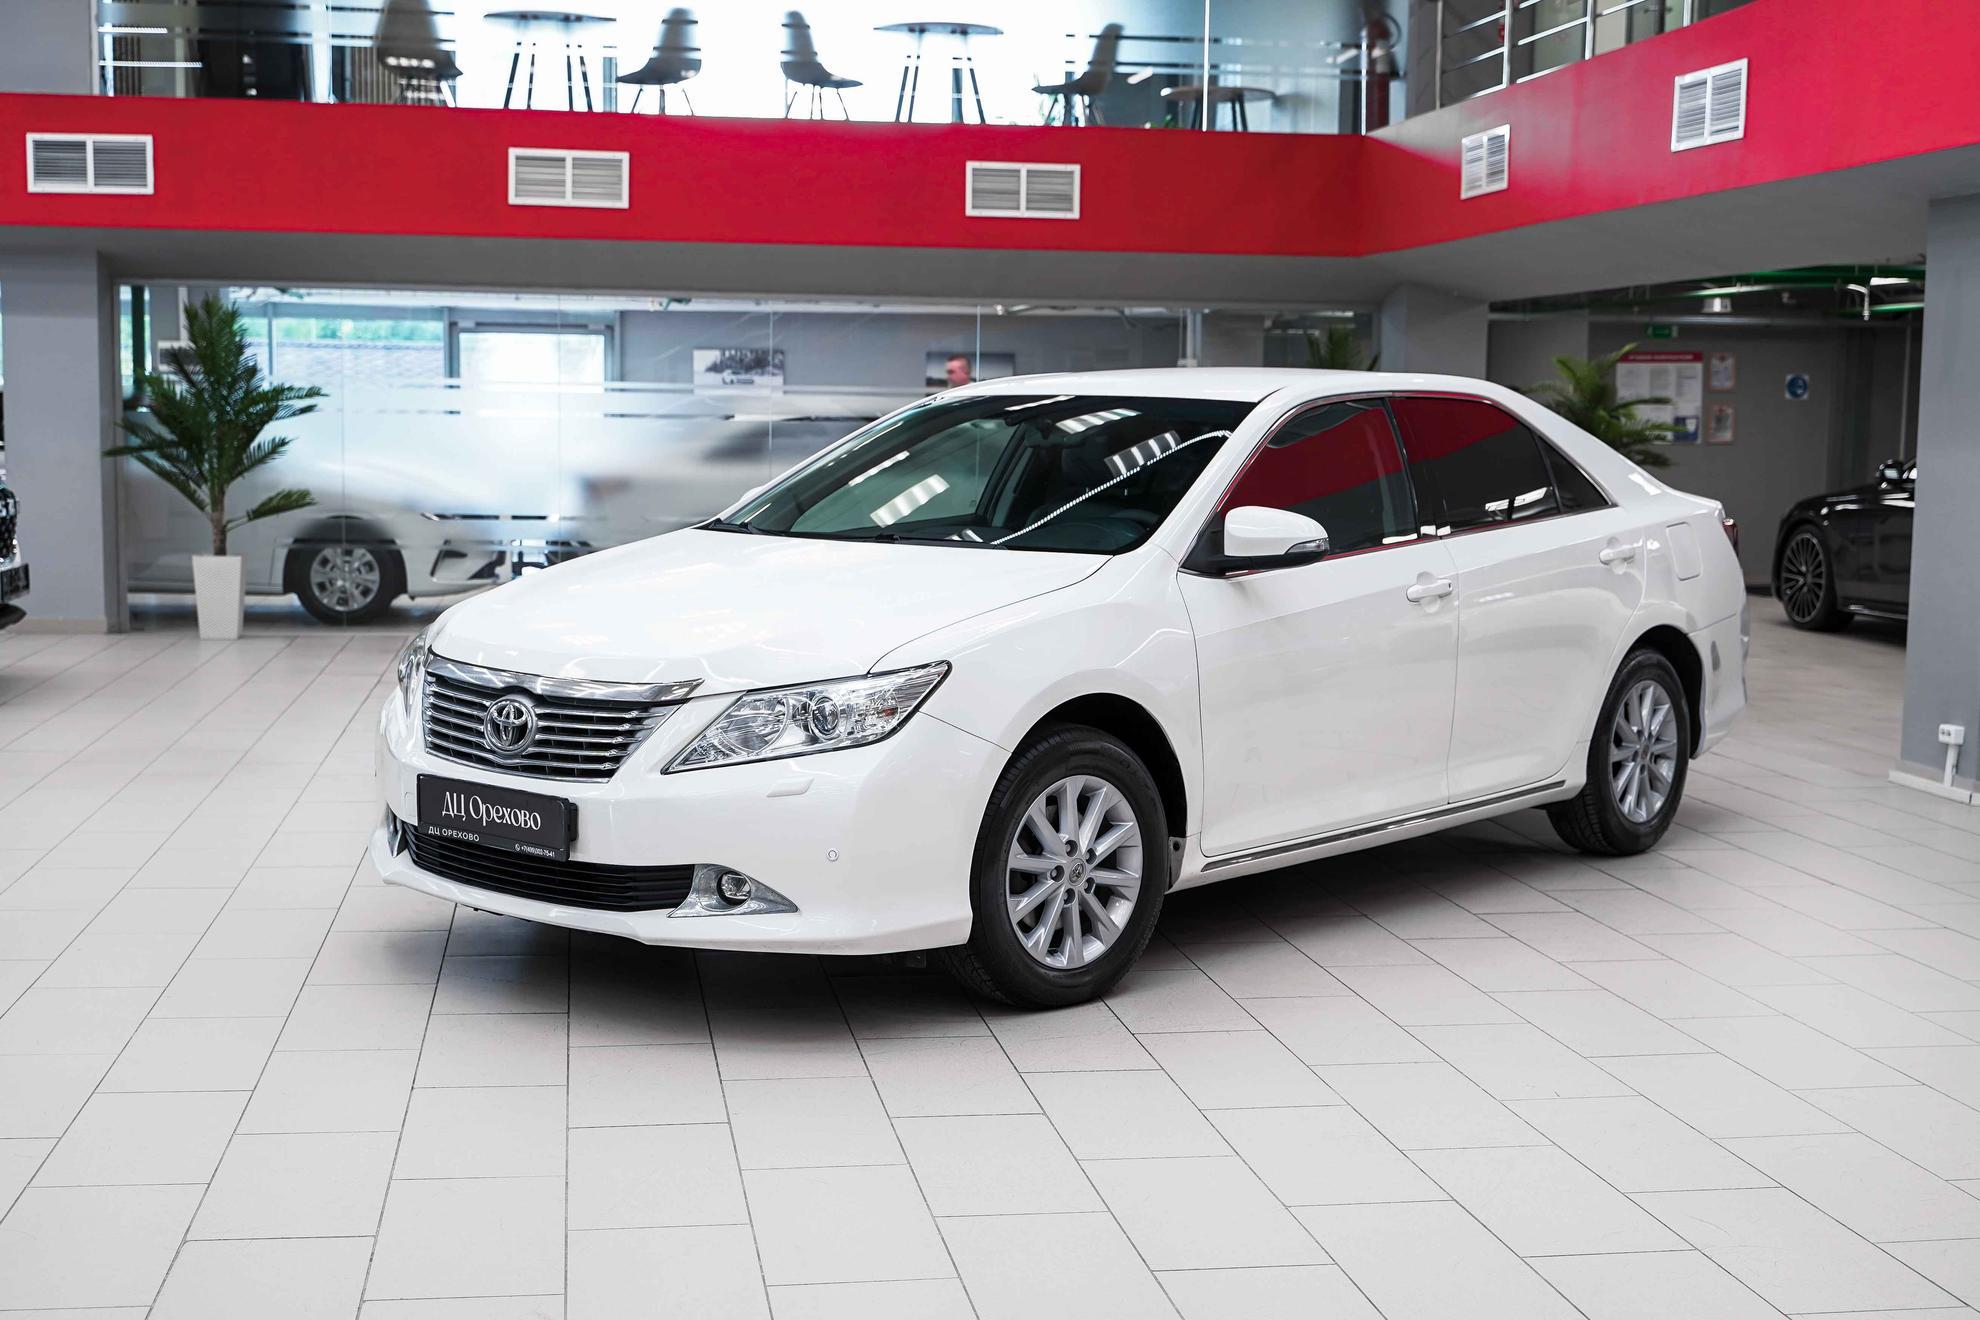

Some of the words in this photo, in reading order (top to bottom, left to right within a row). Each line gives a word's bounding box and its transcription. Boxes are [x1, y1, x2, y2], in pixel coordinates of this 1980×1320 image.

[442, 791, 466, 822] ДЦ
[469, 795, 541, 831] Орехово
[428, 826, 441, 836] ДЦ
[442, 828, 480, 842] ОРЕХОВО
